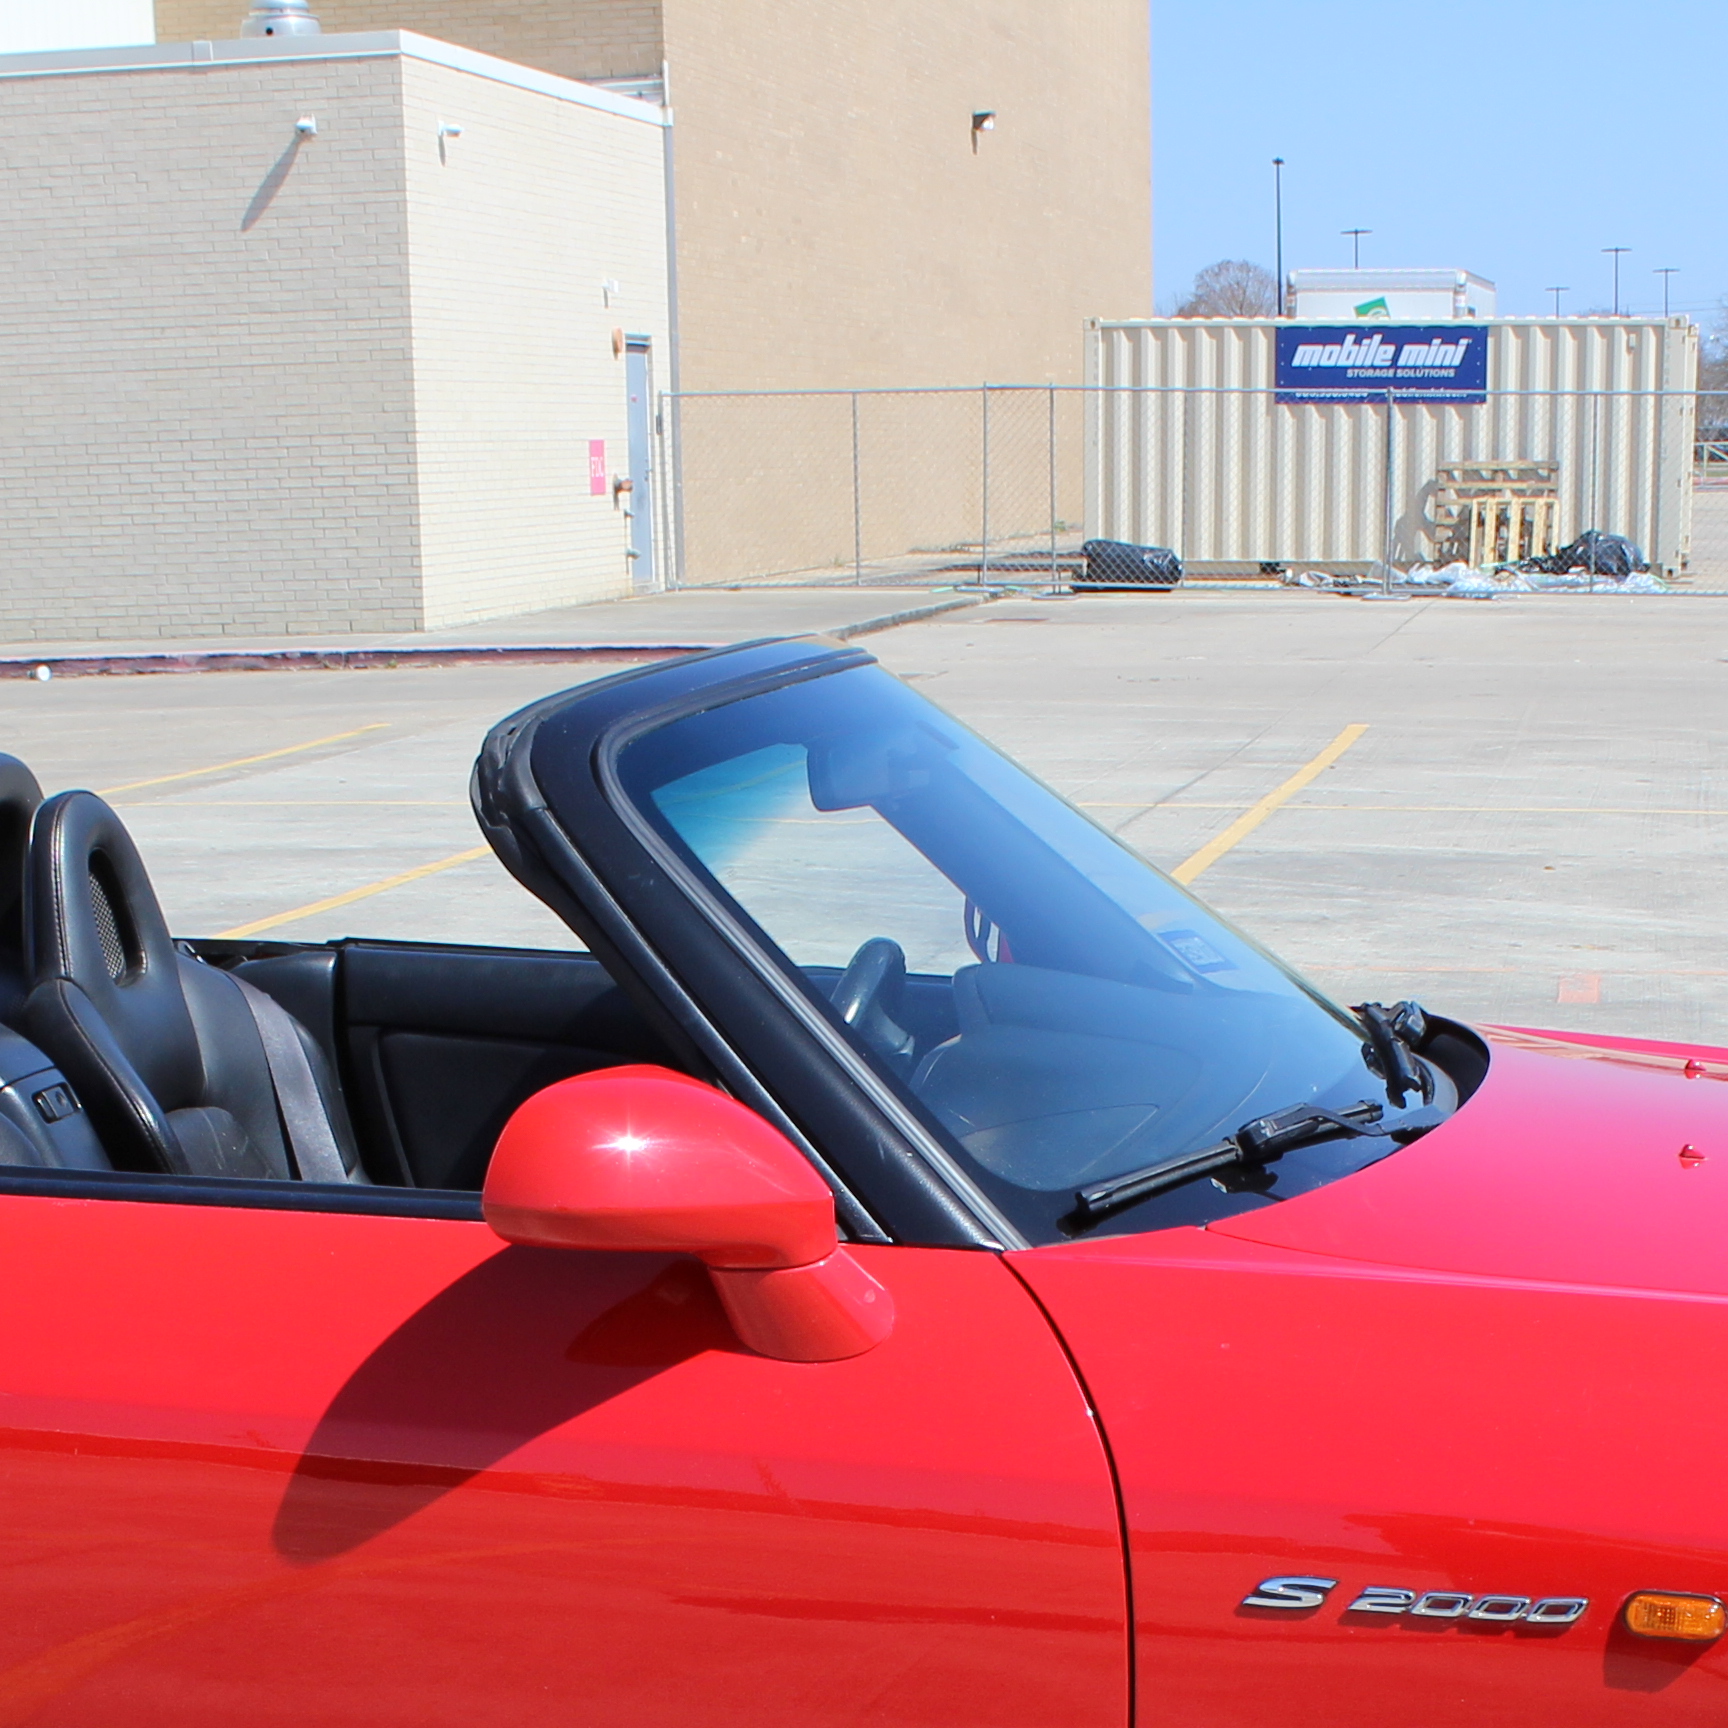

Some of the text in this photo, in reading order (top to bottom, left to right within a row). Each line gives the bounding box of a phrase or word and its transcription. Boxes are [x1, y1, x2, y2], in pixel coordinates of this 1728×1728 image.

[1291, 333, 1469, 367] mobile mini
[1346, 368, 1455, 378] STORAGE SOLUTIONS
